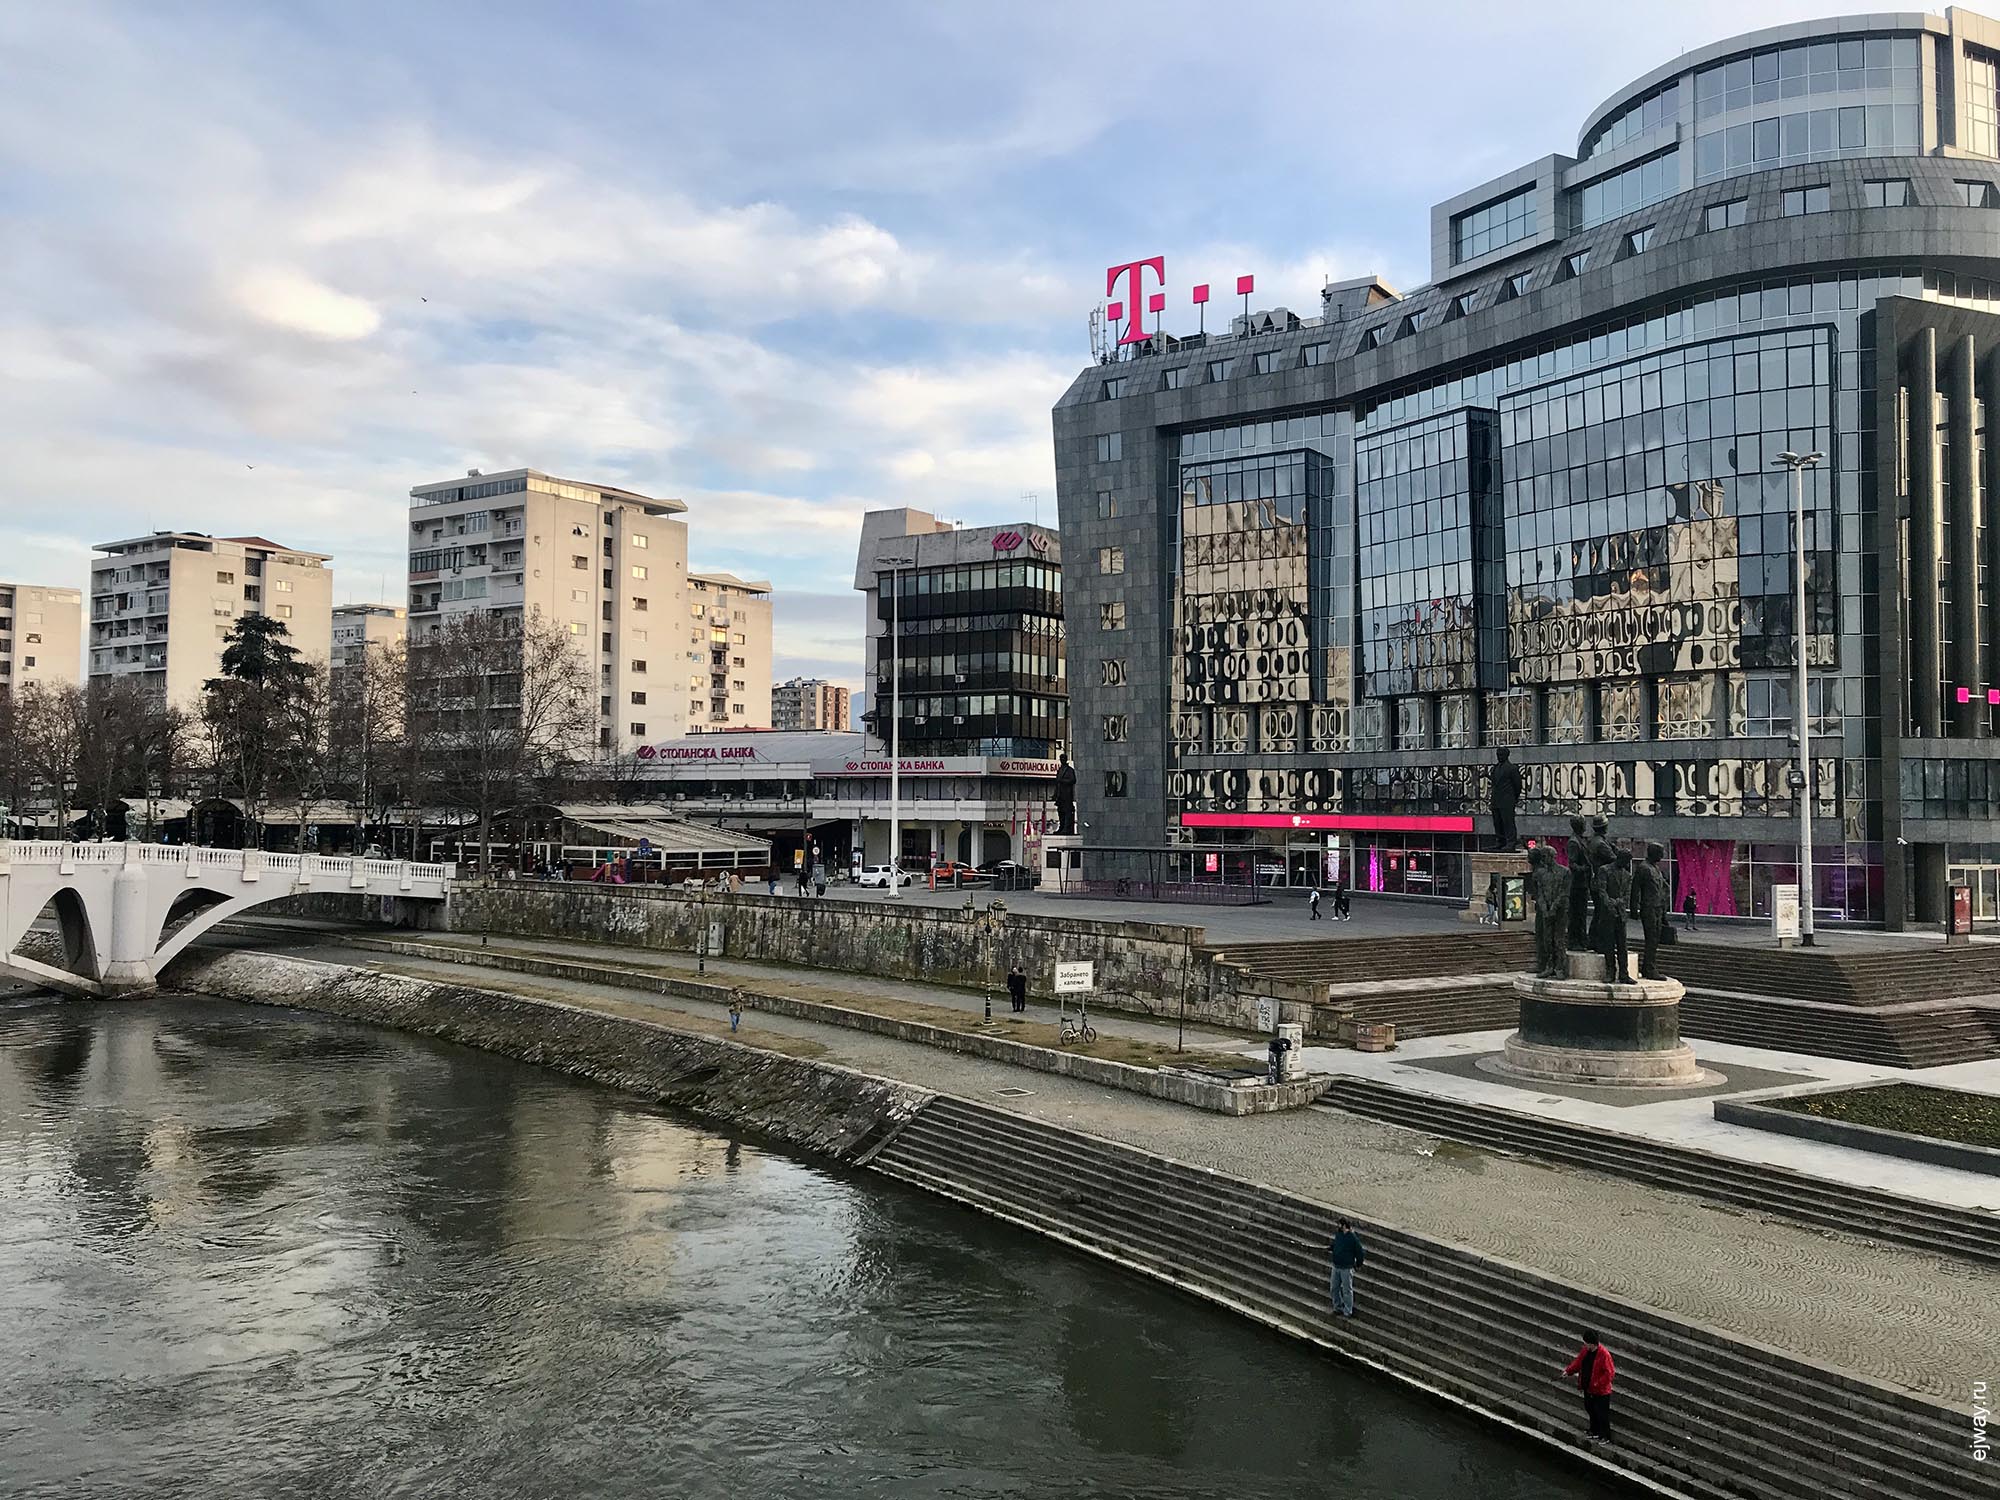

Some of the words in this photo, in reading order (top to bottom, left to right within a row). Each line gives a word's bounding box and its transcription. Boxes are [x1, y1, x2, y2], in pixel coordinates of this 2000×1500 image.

[1106, 255, 1165, 345] T
[660, 747, 717, 759] СТОПАНСКА
[721, 746, 755, 758] БАНКА
[860, 761, 912, 770] СТОПАНКА
[914, 760, 945, 770] БАНКА
[1011, 761, 1049, 772] СТОПАНСКА
[1060, 971, 1089, 979] Забрането
